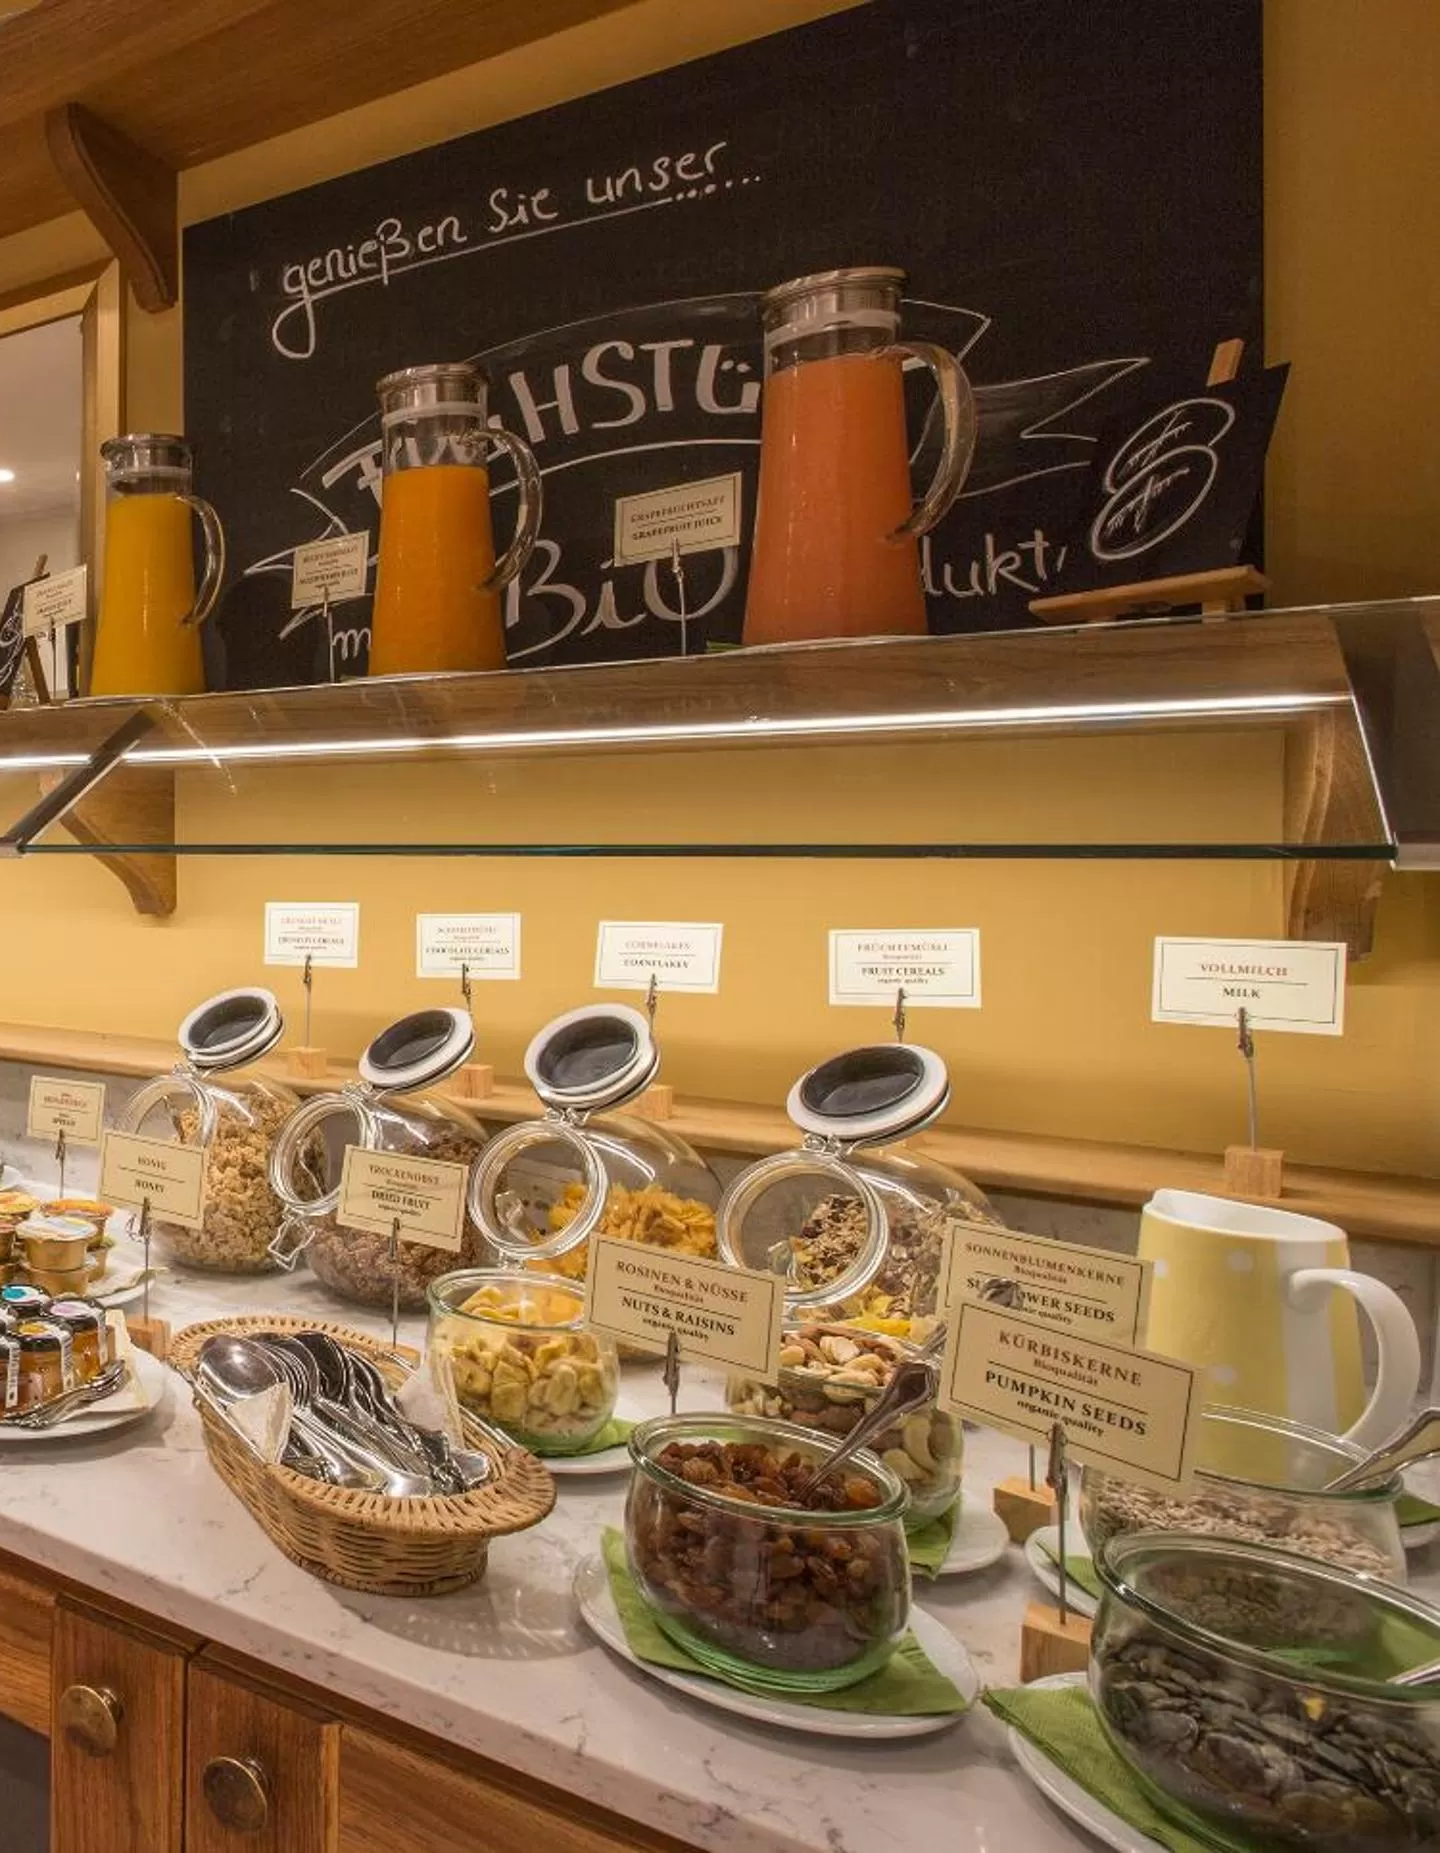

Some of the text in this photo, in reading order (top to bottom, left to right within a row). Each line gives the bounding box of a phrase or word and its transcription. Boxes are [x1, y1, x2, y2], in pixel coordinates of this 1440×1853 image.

[272, 219, 467, 359] genießen
[486, 186, 559, 234] Sie
[861, 967, 945, 977] FRUIT CEREALS
[1199, 963, 1288, 977] VOLLMILCH
[1222, 986, 1261, 999] MILK
[135, 1178, 166, 1194] HONEY
[402, 1195, 431, 1210] FRUIT
[964, 1241, 1126, 1286] SONNENBLUMENKERNE
[616, 1260, 750, 1303] ROSINEN & NÜSSE
[622, 1296, 735, 1336] NUTS & RAISINS
[1038, 1309, 1074, 1325] quality
[1064, 1300, 1116, 1323] SEEDS
[998, 1329, 1142, 1387] KÜRBISKERNE
[1033, 1357, 1099, 1387] Bioqualität
[985, 1370, 1148, 1436] PUMPKIN SEEDS
[1016, 1400, 1105, 1437] organic quality
